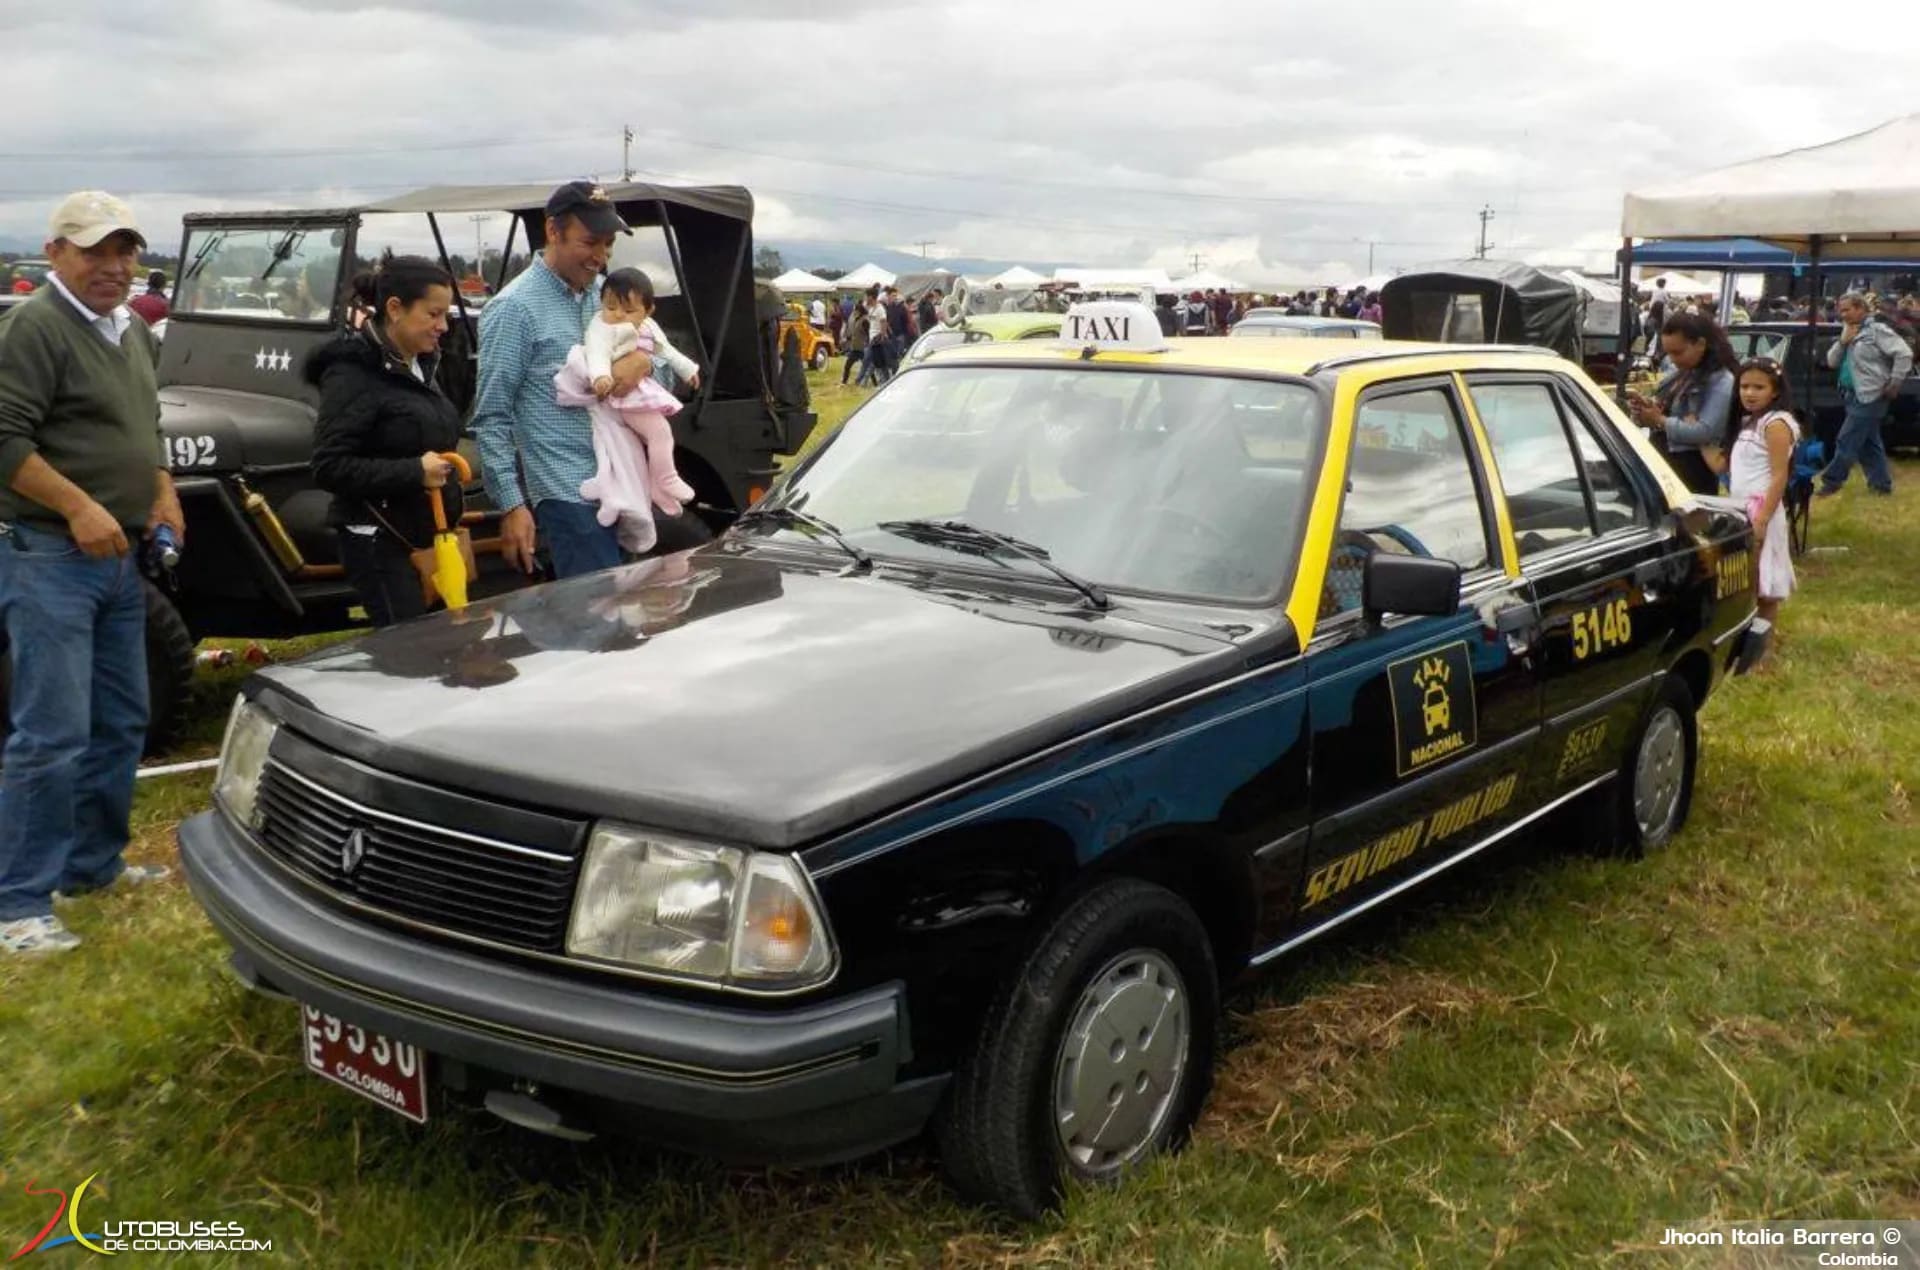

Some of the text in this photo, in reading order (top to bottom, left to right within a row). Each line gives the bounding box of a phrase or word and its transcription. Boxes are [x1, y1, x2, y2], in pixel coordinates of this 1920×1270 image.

[1069, 314, 1130, 341] TAXI
[1572, 599, 1632, 659] 5146
[1413, 657, 1450, 689] TAXI
[1411, 731, 1465, 766] NACIONAL
[1301, 772, 1518, 912] SERVICIO PUBLICO
[336, 1061, 406, 1107] COLOMBIA
